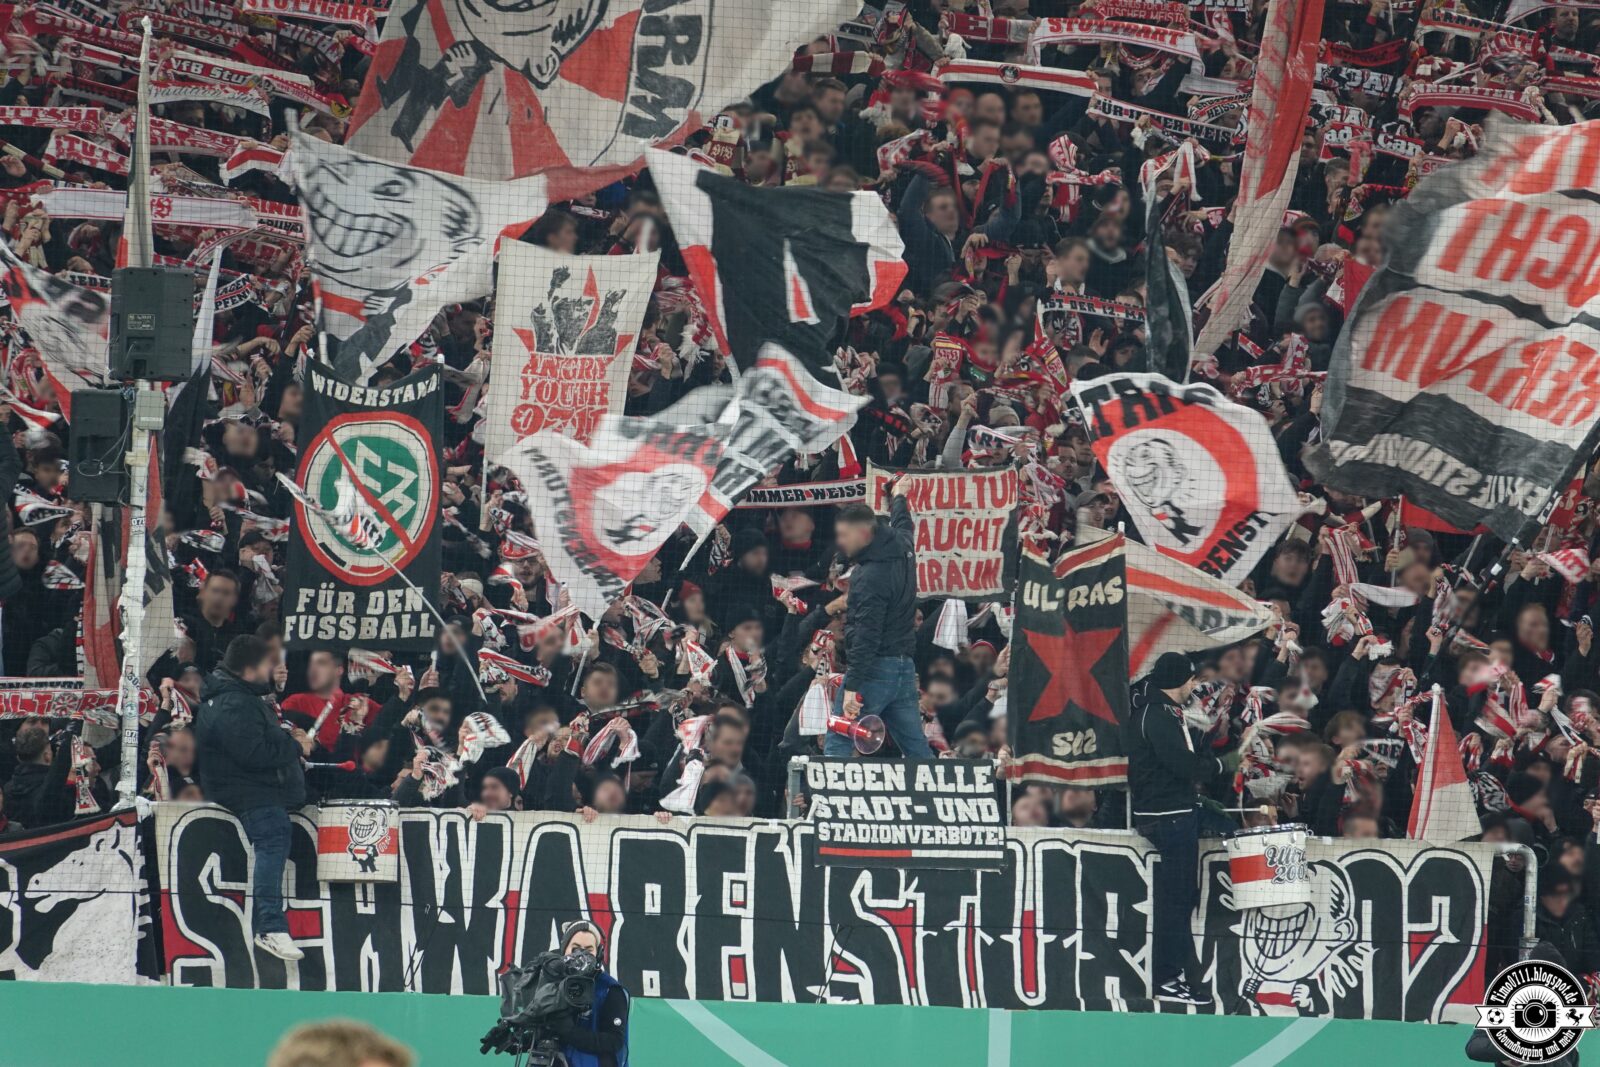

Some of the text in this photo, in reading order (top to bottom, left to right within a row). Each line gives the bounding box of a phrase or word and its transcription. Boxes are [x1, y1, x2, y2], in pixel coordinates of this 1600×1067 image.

[170, 57, 204, 75] VfB
[1324, 125, 1353, 142] ad
[1377, 132, 1422, 157] Can
[1070, 300, 1096, 313] DER
[311, 370, 441, 407] WIDERSTAND!
[520, 376, 610, 408] YOUTH
[810, 479, 867, 501] WEISS
[915, 557, 1001, 593] IRAUM
[296, 582, 424, 615] FÜR DEN
[1022, 575, 1124, 613] ULRAS
[283, 612, 436, 643] FUSSBALL
[806, 762, 995, 793] GEGEN ALLE
[811, 794, 1000, 823] STADT- UND
[818, 821, 1004, 846] STADIONVERBOTE!
